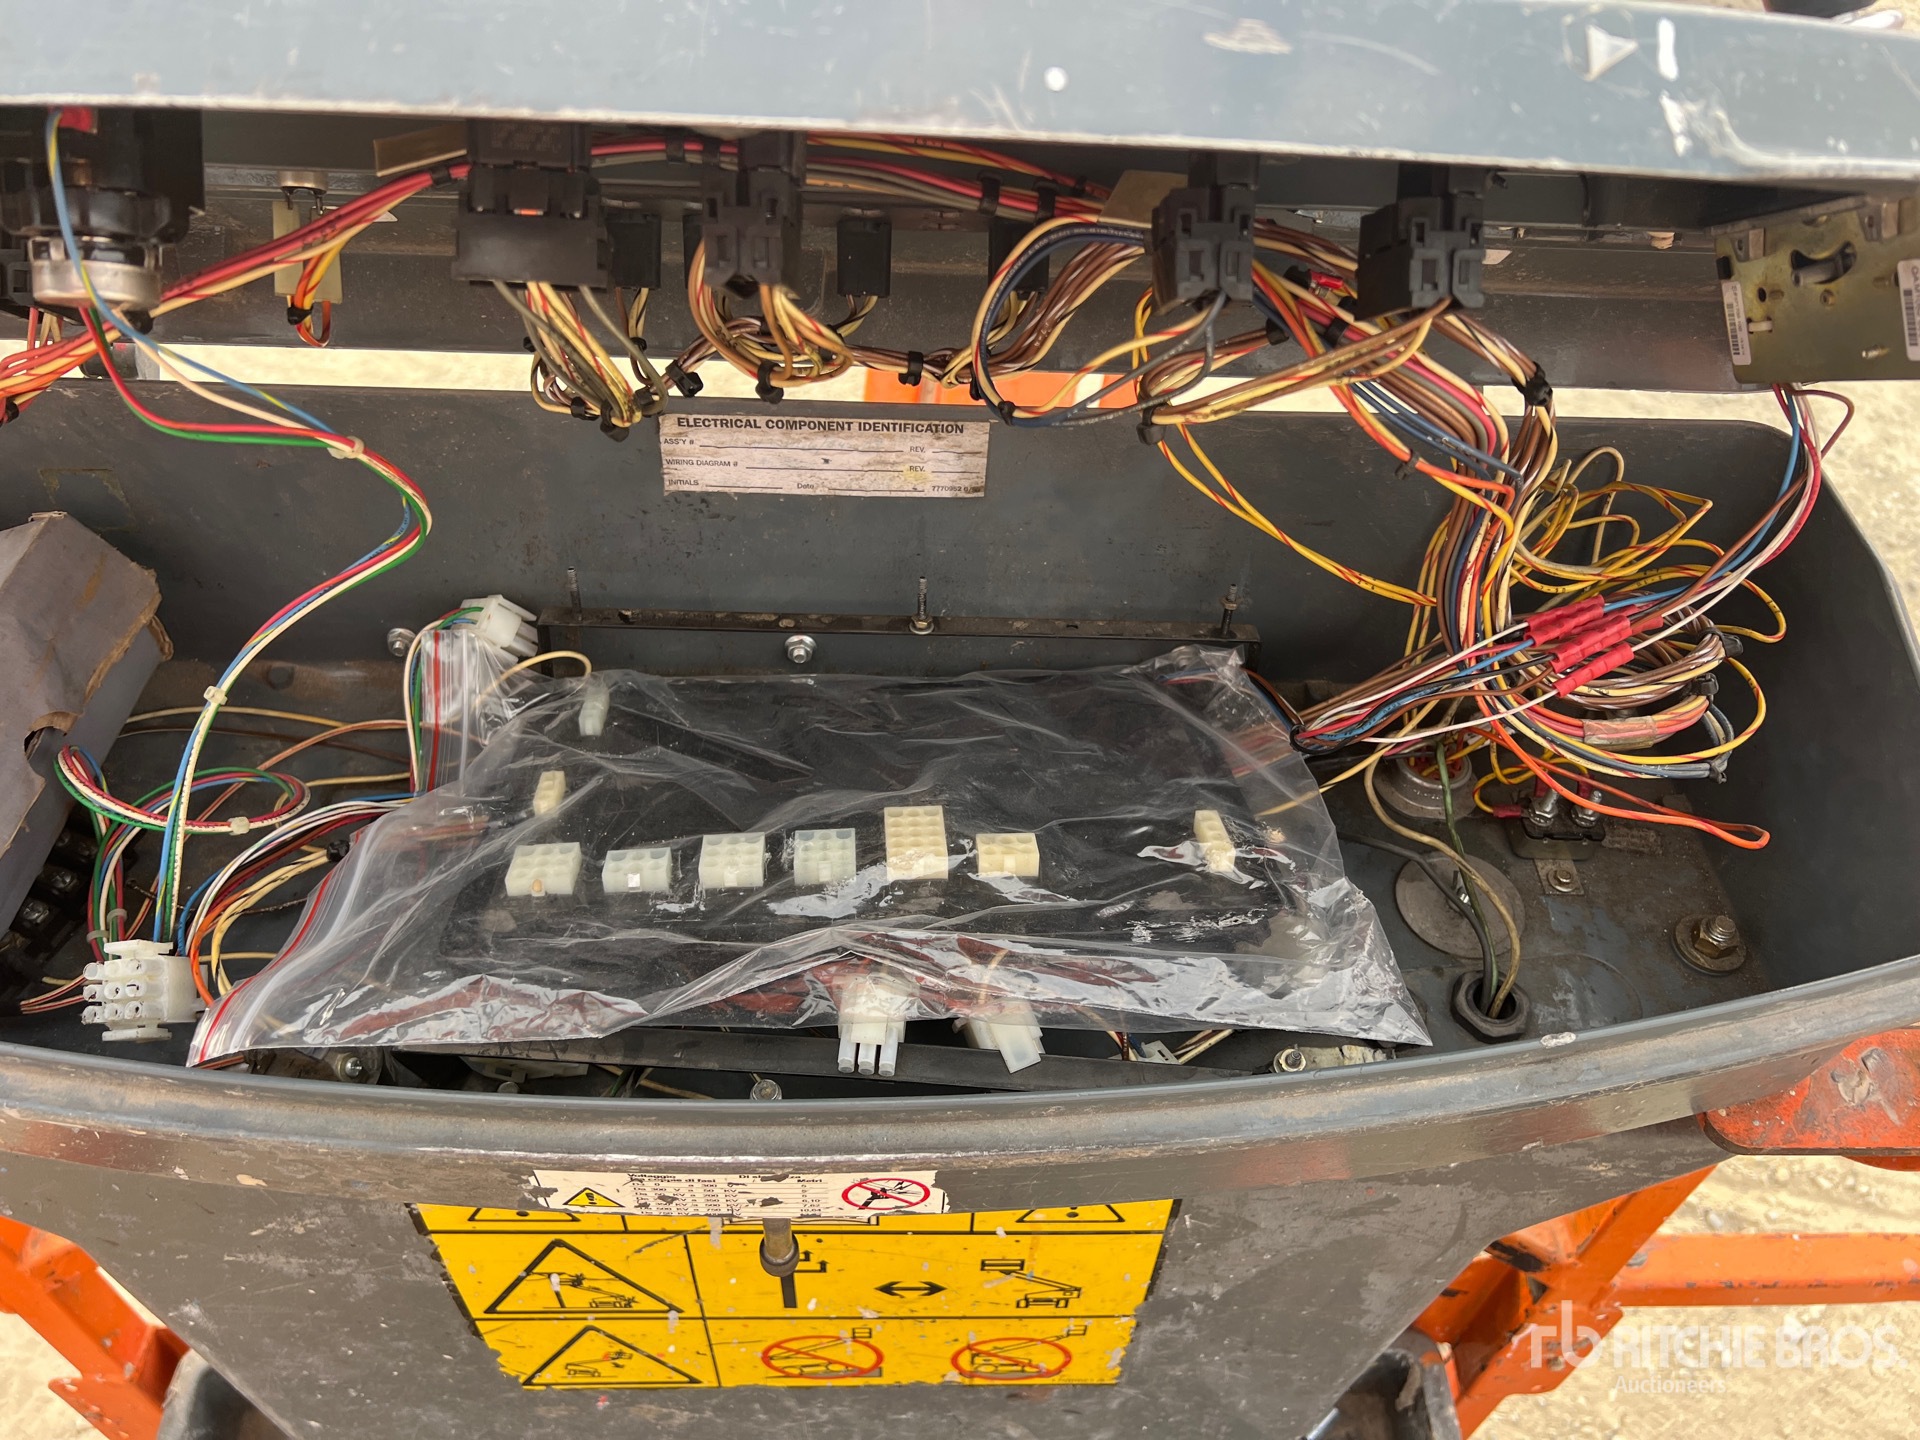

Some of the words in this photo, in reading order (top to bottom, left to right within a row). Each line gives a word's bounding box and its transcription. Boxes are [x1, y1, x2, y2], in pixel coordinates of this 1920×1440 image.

[677, 417, 762, 429] ELECTRICAL
[765, 419, 853, 431] COMPONENT
[858, 421, 964, 434] IDENTIFICATION
[665, 458, 694, 466] WIRING
